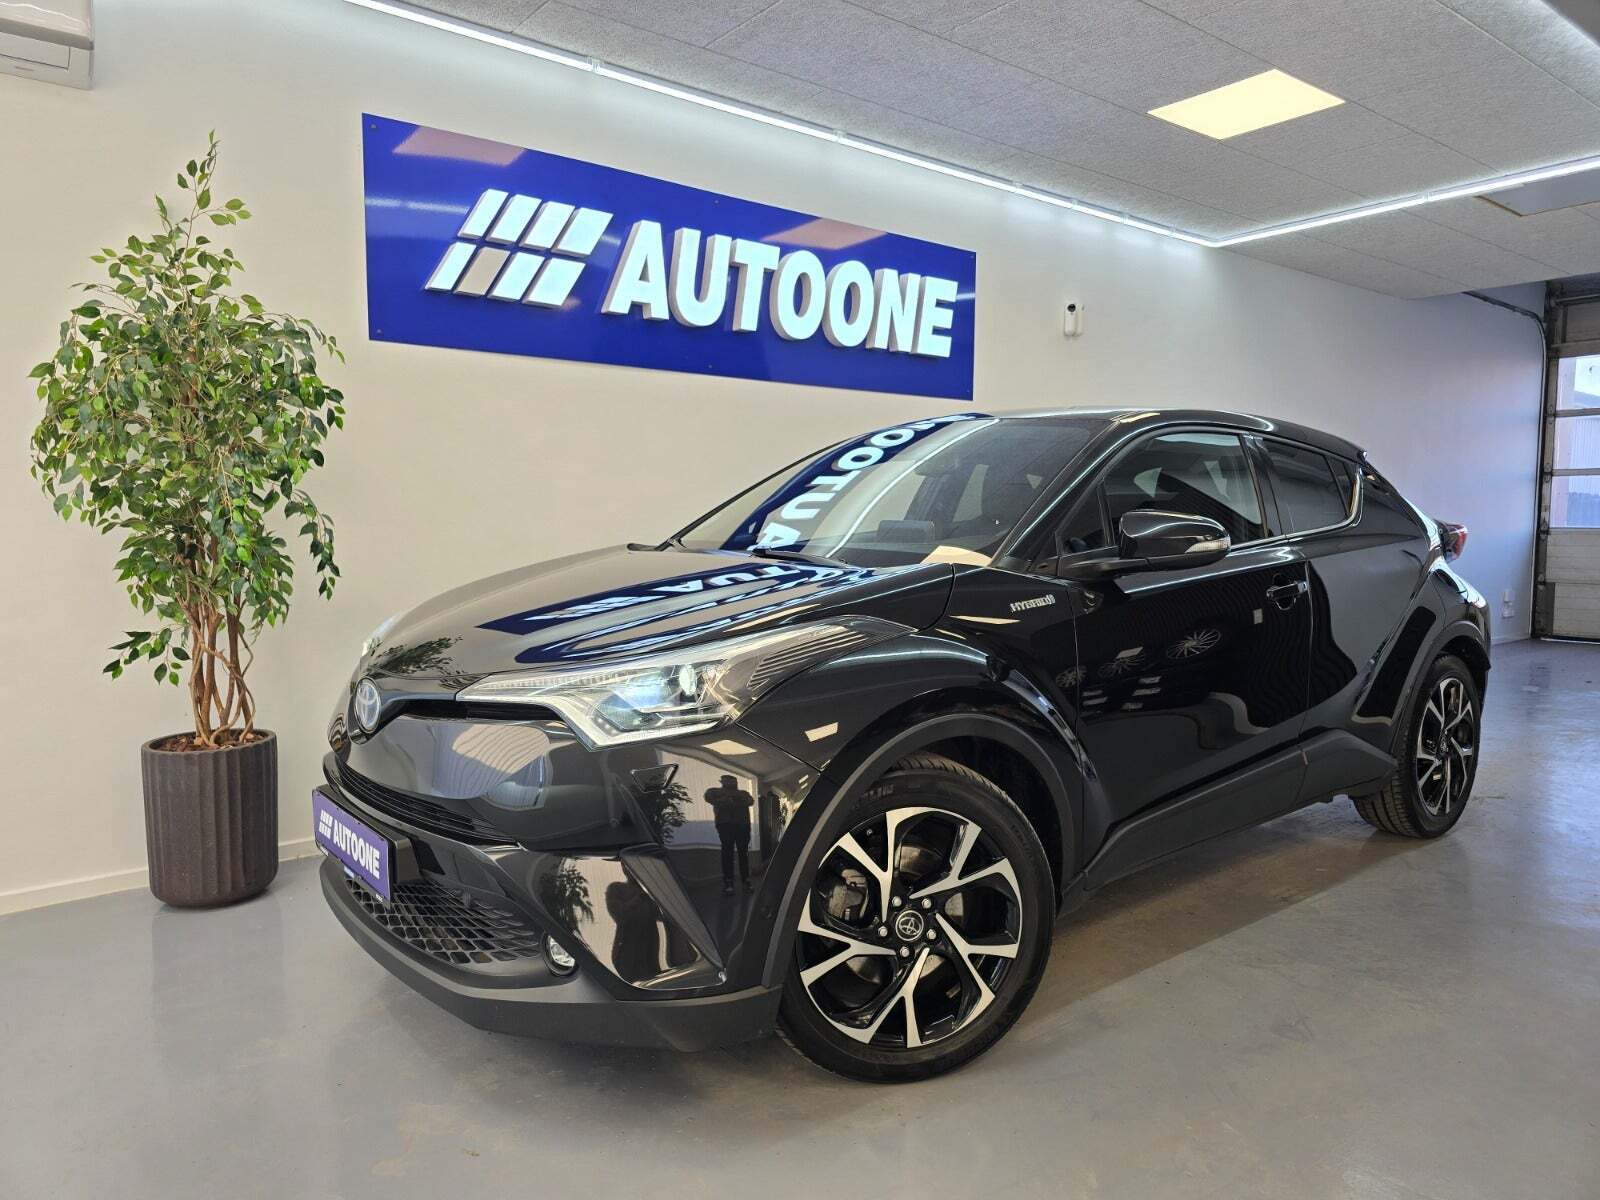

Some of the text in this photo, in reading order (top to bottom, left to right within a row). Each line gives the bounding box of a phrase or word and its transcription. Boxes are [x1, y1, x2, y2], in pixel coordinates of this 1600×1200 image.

[603, 219, 959, 358] AUTOONE
[1010, 594, 1052, 612] HYBRID
[333, 819, 380, 880] AUTOONE
